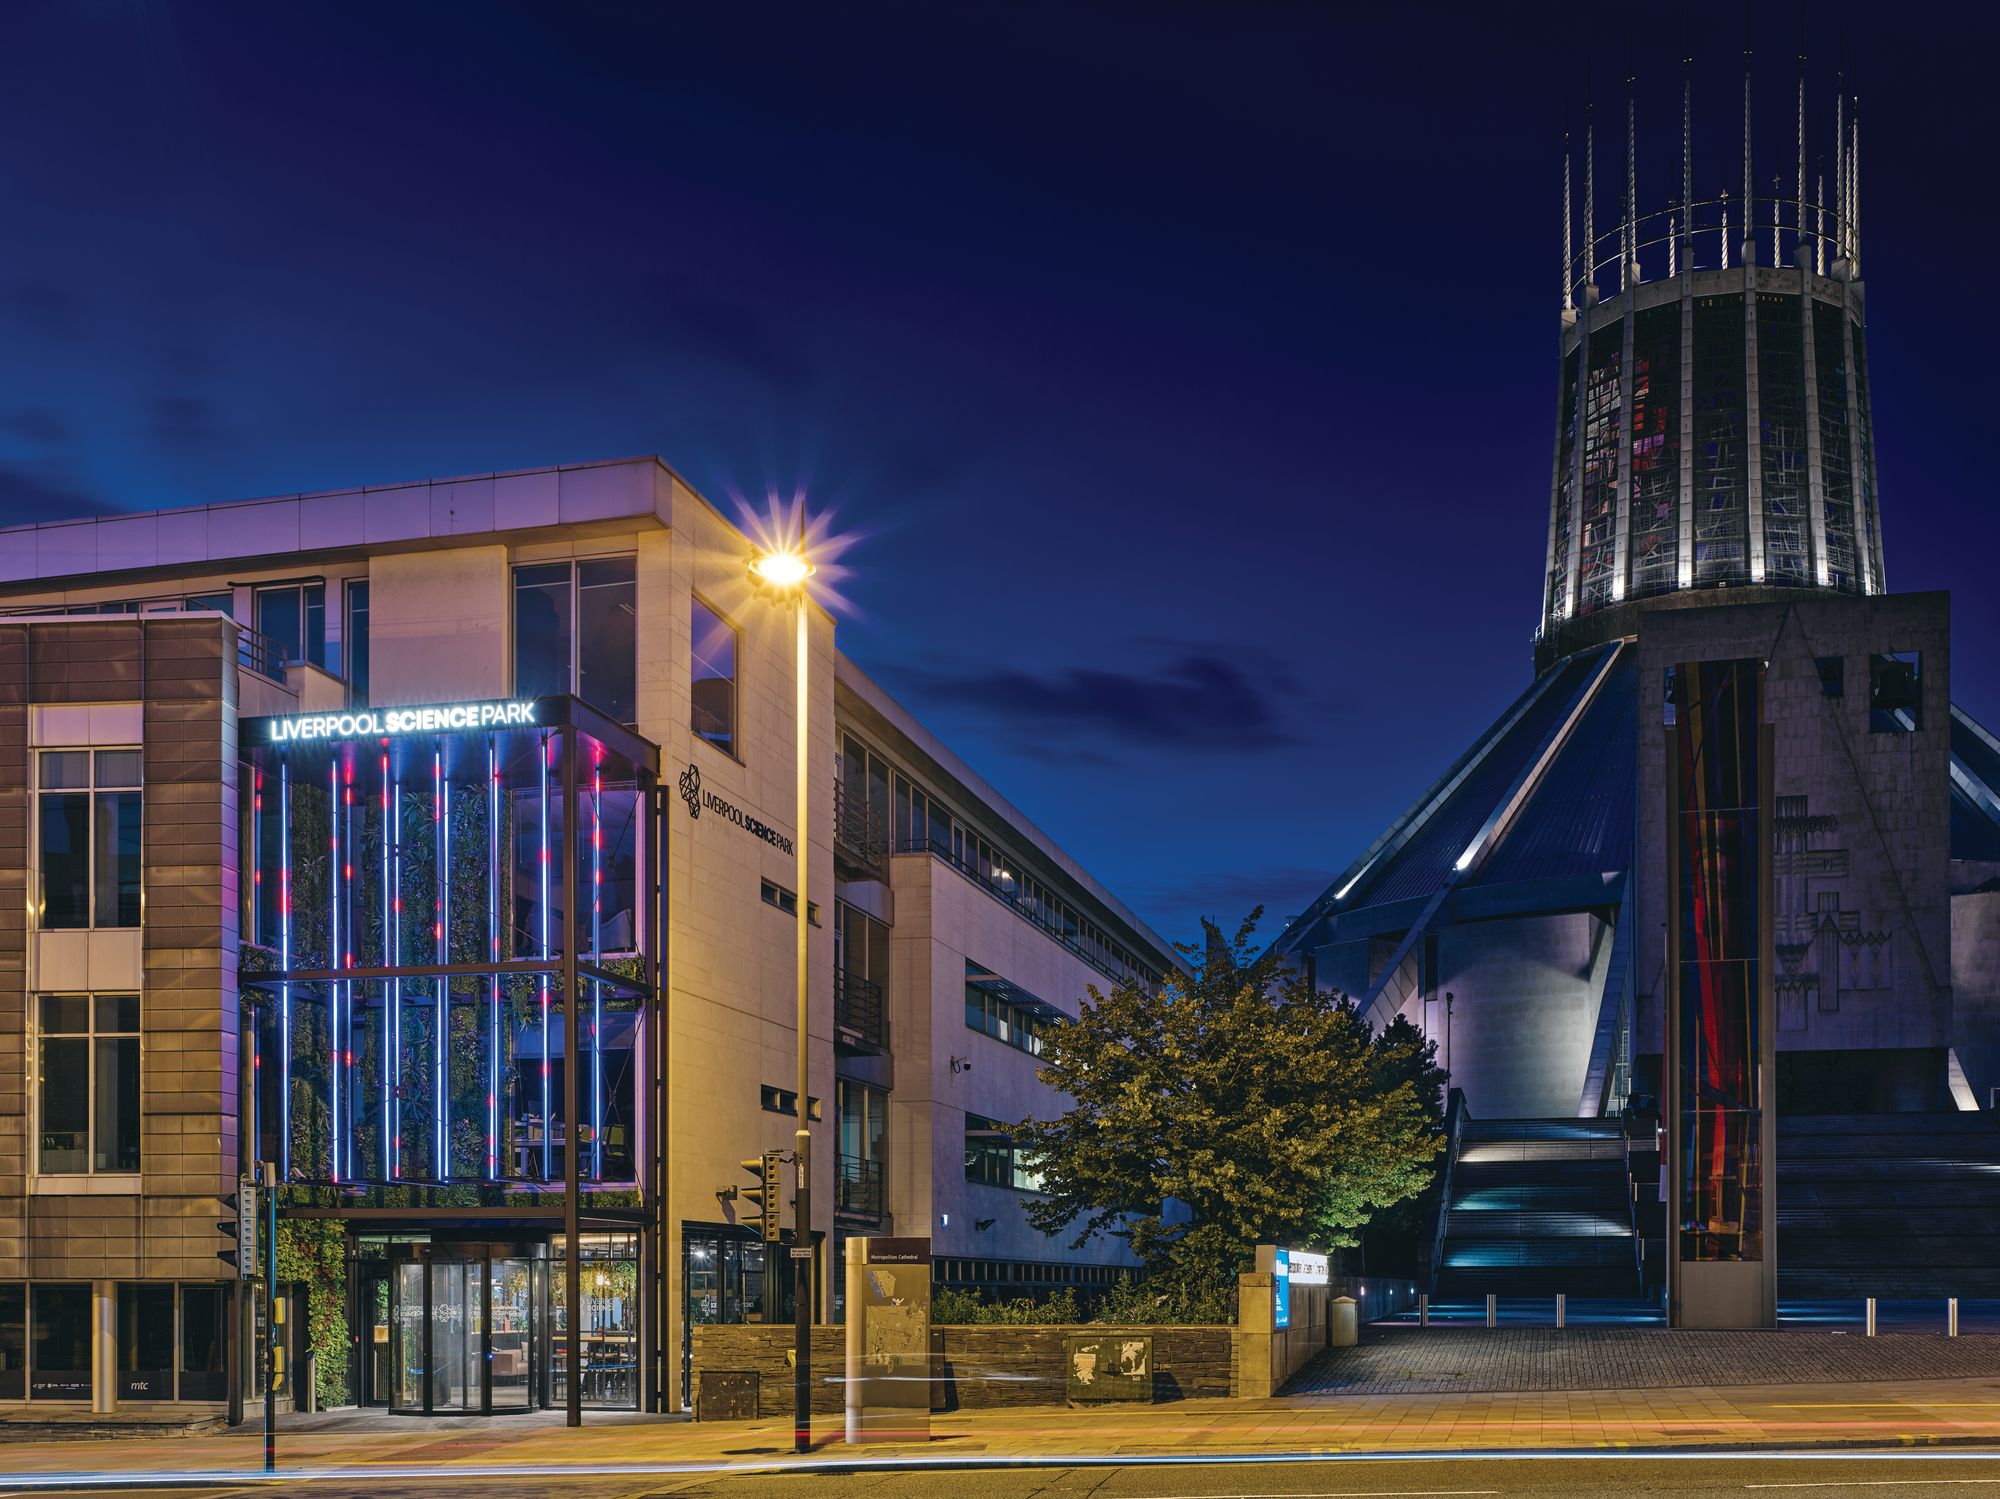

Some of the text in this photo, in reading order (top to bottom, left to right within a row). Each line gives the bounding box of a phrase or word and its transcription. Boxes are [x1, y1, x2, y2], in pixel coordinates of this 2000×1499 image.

[270, 702, 535, 741] LIVERPOOL SCIENCE PARK
[703, 789, 794, 857] LIVERPOOL SCIENCE PARK
[131, 1382, 149, 1390] mtc
